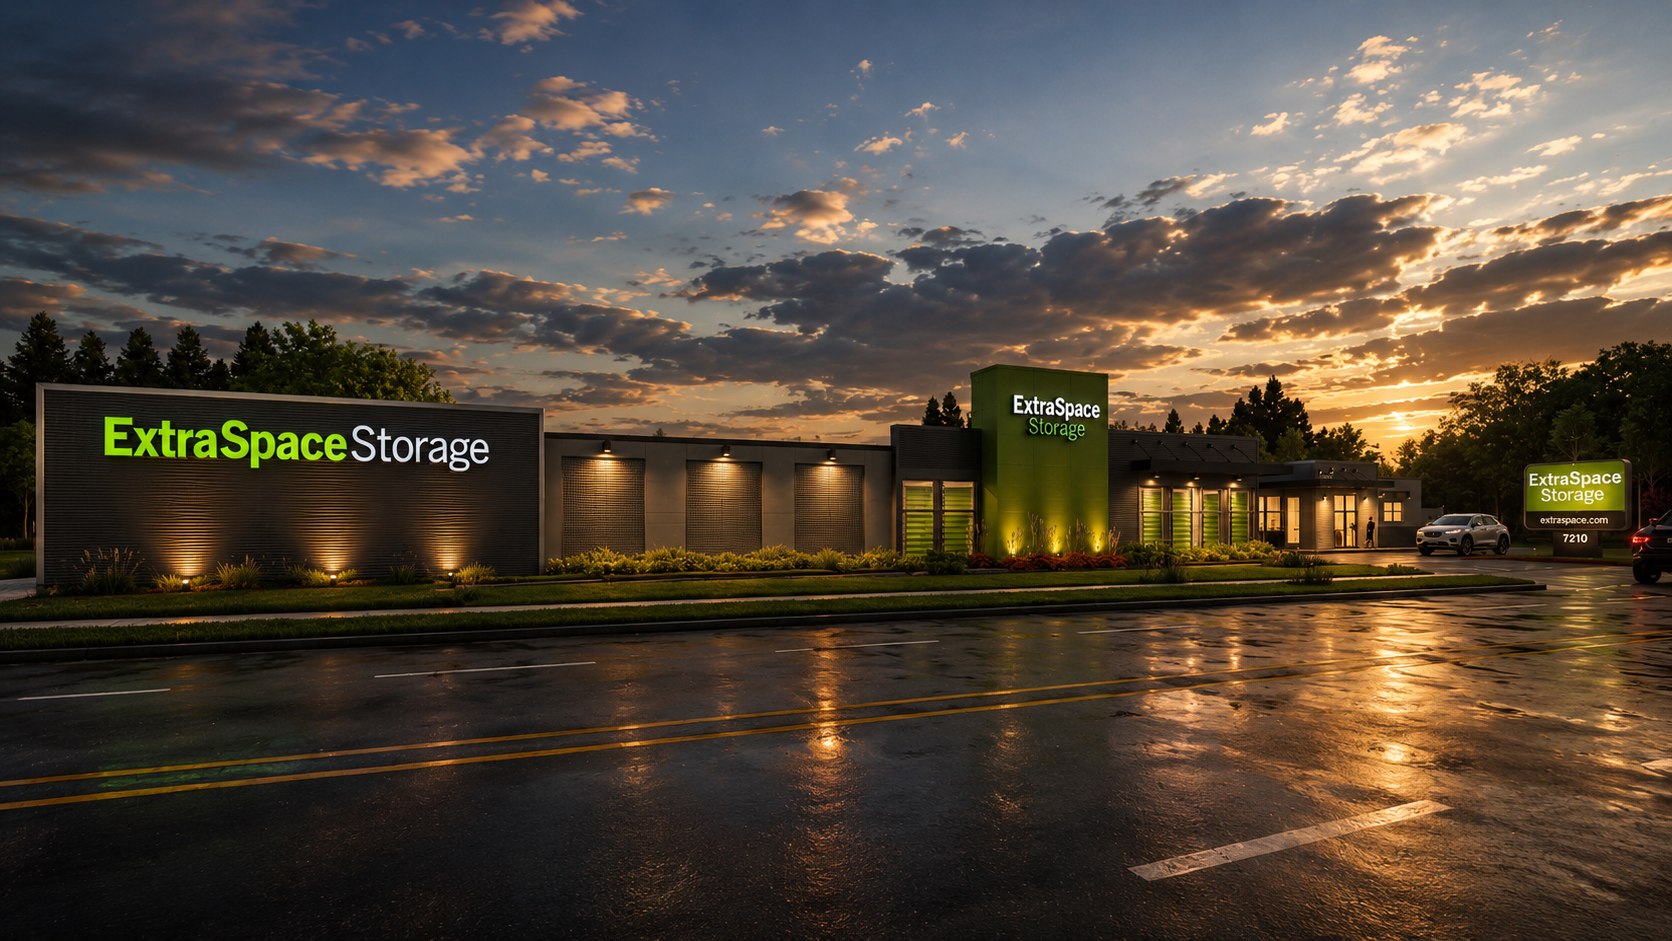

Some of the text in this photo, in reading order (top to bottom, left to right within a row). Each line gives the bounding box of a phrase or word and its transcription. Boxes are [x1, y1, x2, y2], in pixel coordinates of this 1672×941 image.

[1013, 394, 1100, 421] ExtraSpace
[1029, 417, 1085, 441] Storage
[103, 416, 490, 472] ExtraSpace Storage
[1529, 471, 1622, 488] ExtraSpace
[1541, 488, 1604, 504] Storage
[1540, 516, 1608, 525] extraspace.com
[1563, 534, 1588, 543] 7210
